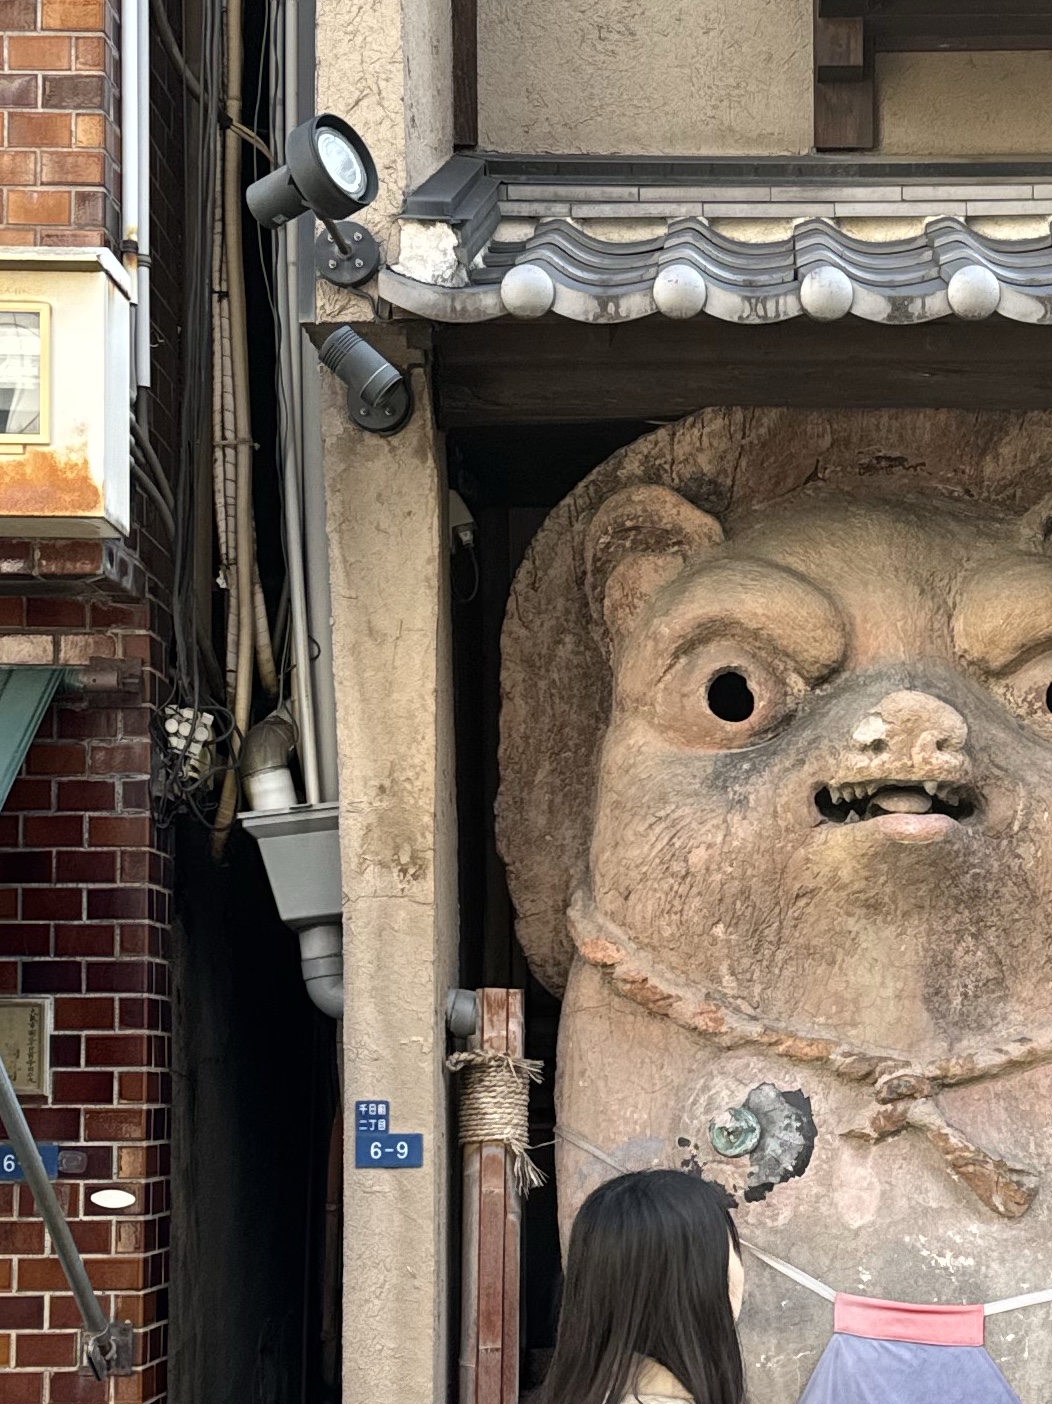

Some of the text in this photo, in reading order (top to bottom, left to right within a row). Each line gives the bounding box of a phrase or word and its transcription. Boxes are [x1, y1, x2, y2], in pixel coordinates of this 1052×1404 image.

[359, 1119, 386, 1131] 二丁目
[370, 1141, 408, 1160] 6-9
[3, 1154, 20, 1173] 6
